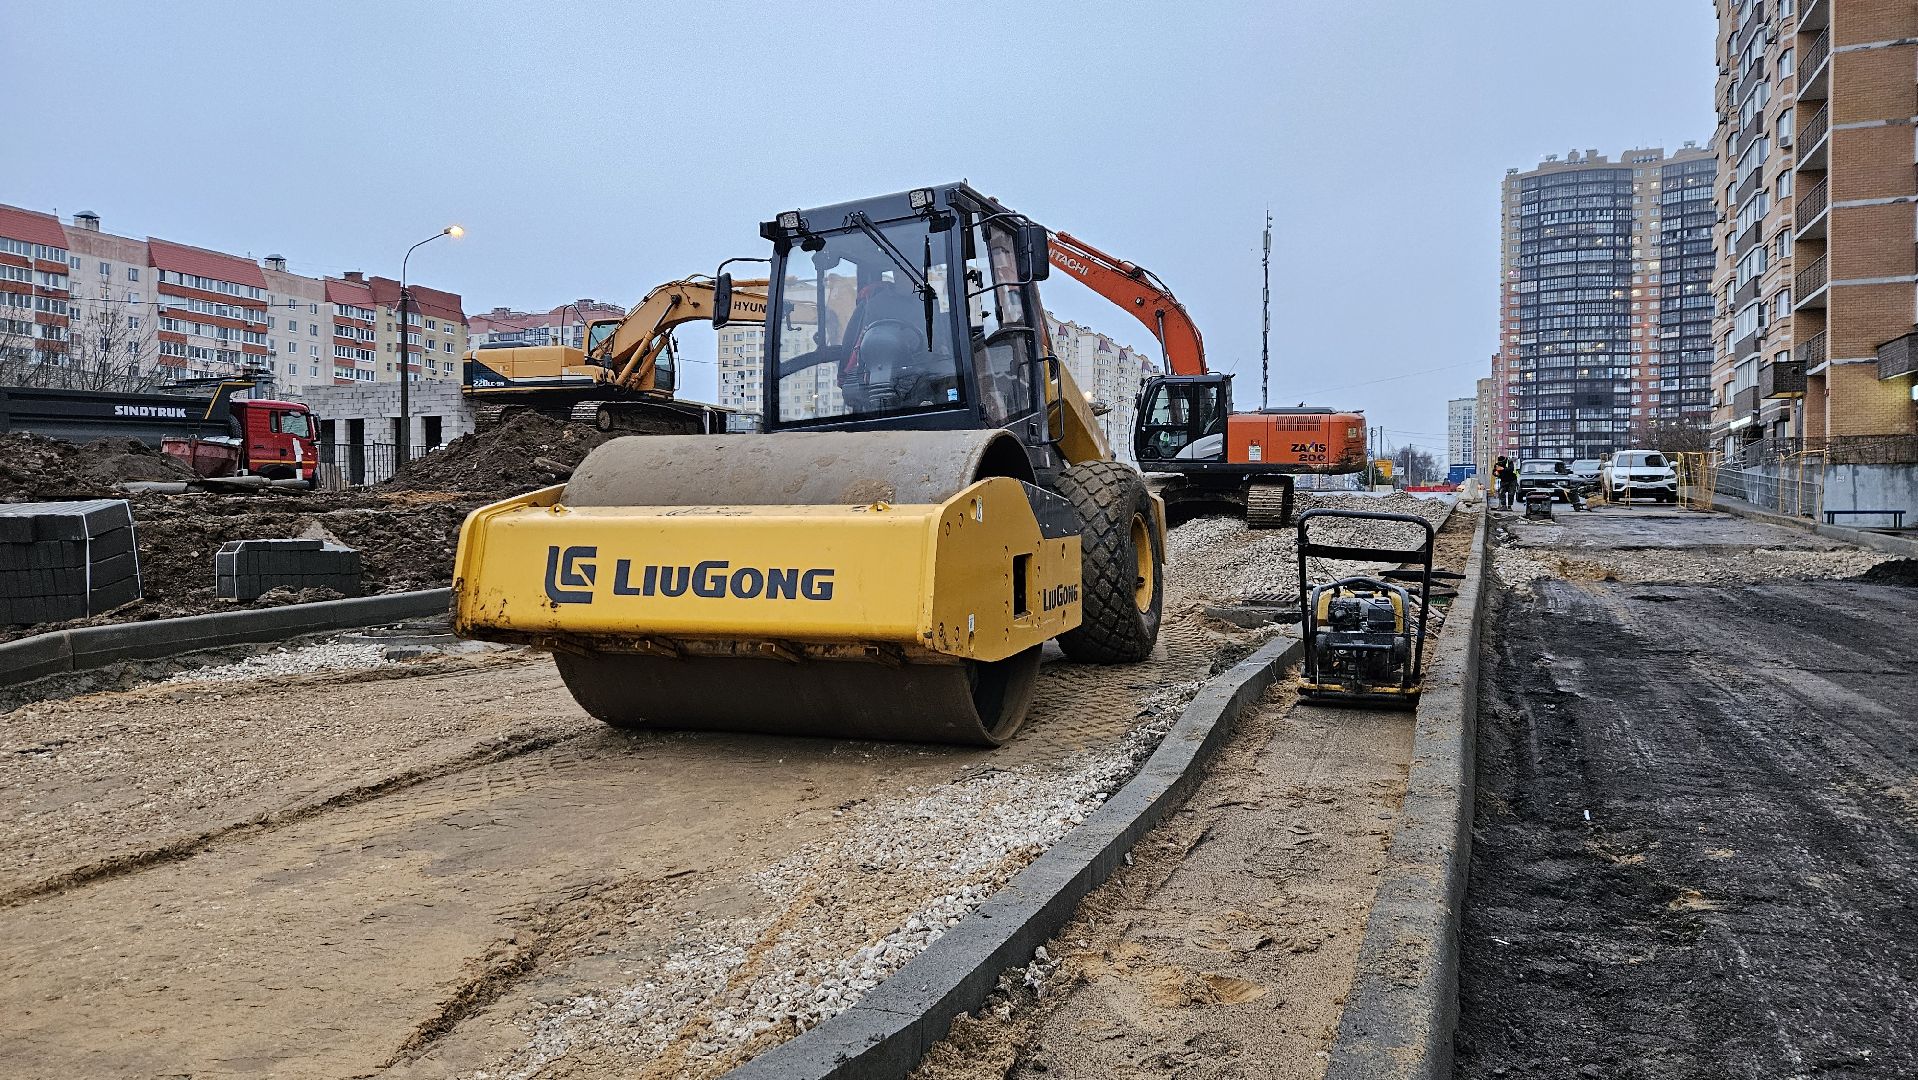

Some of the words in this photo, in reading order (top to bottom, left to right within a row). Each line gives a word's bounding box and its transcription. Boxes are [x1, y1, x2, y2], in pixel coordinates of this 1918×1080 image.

[734, 301, 767, 313] HYUN
[114, 405, 187, 418] SINOTRUK
[1291, 442, 1327, 453] ZAXIS
[1298, 454, 1326, 462] 200
[613, 559, 835, 600] LIUGONG
[1043, 584, 1078, 611] LIUGONG
